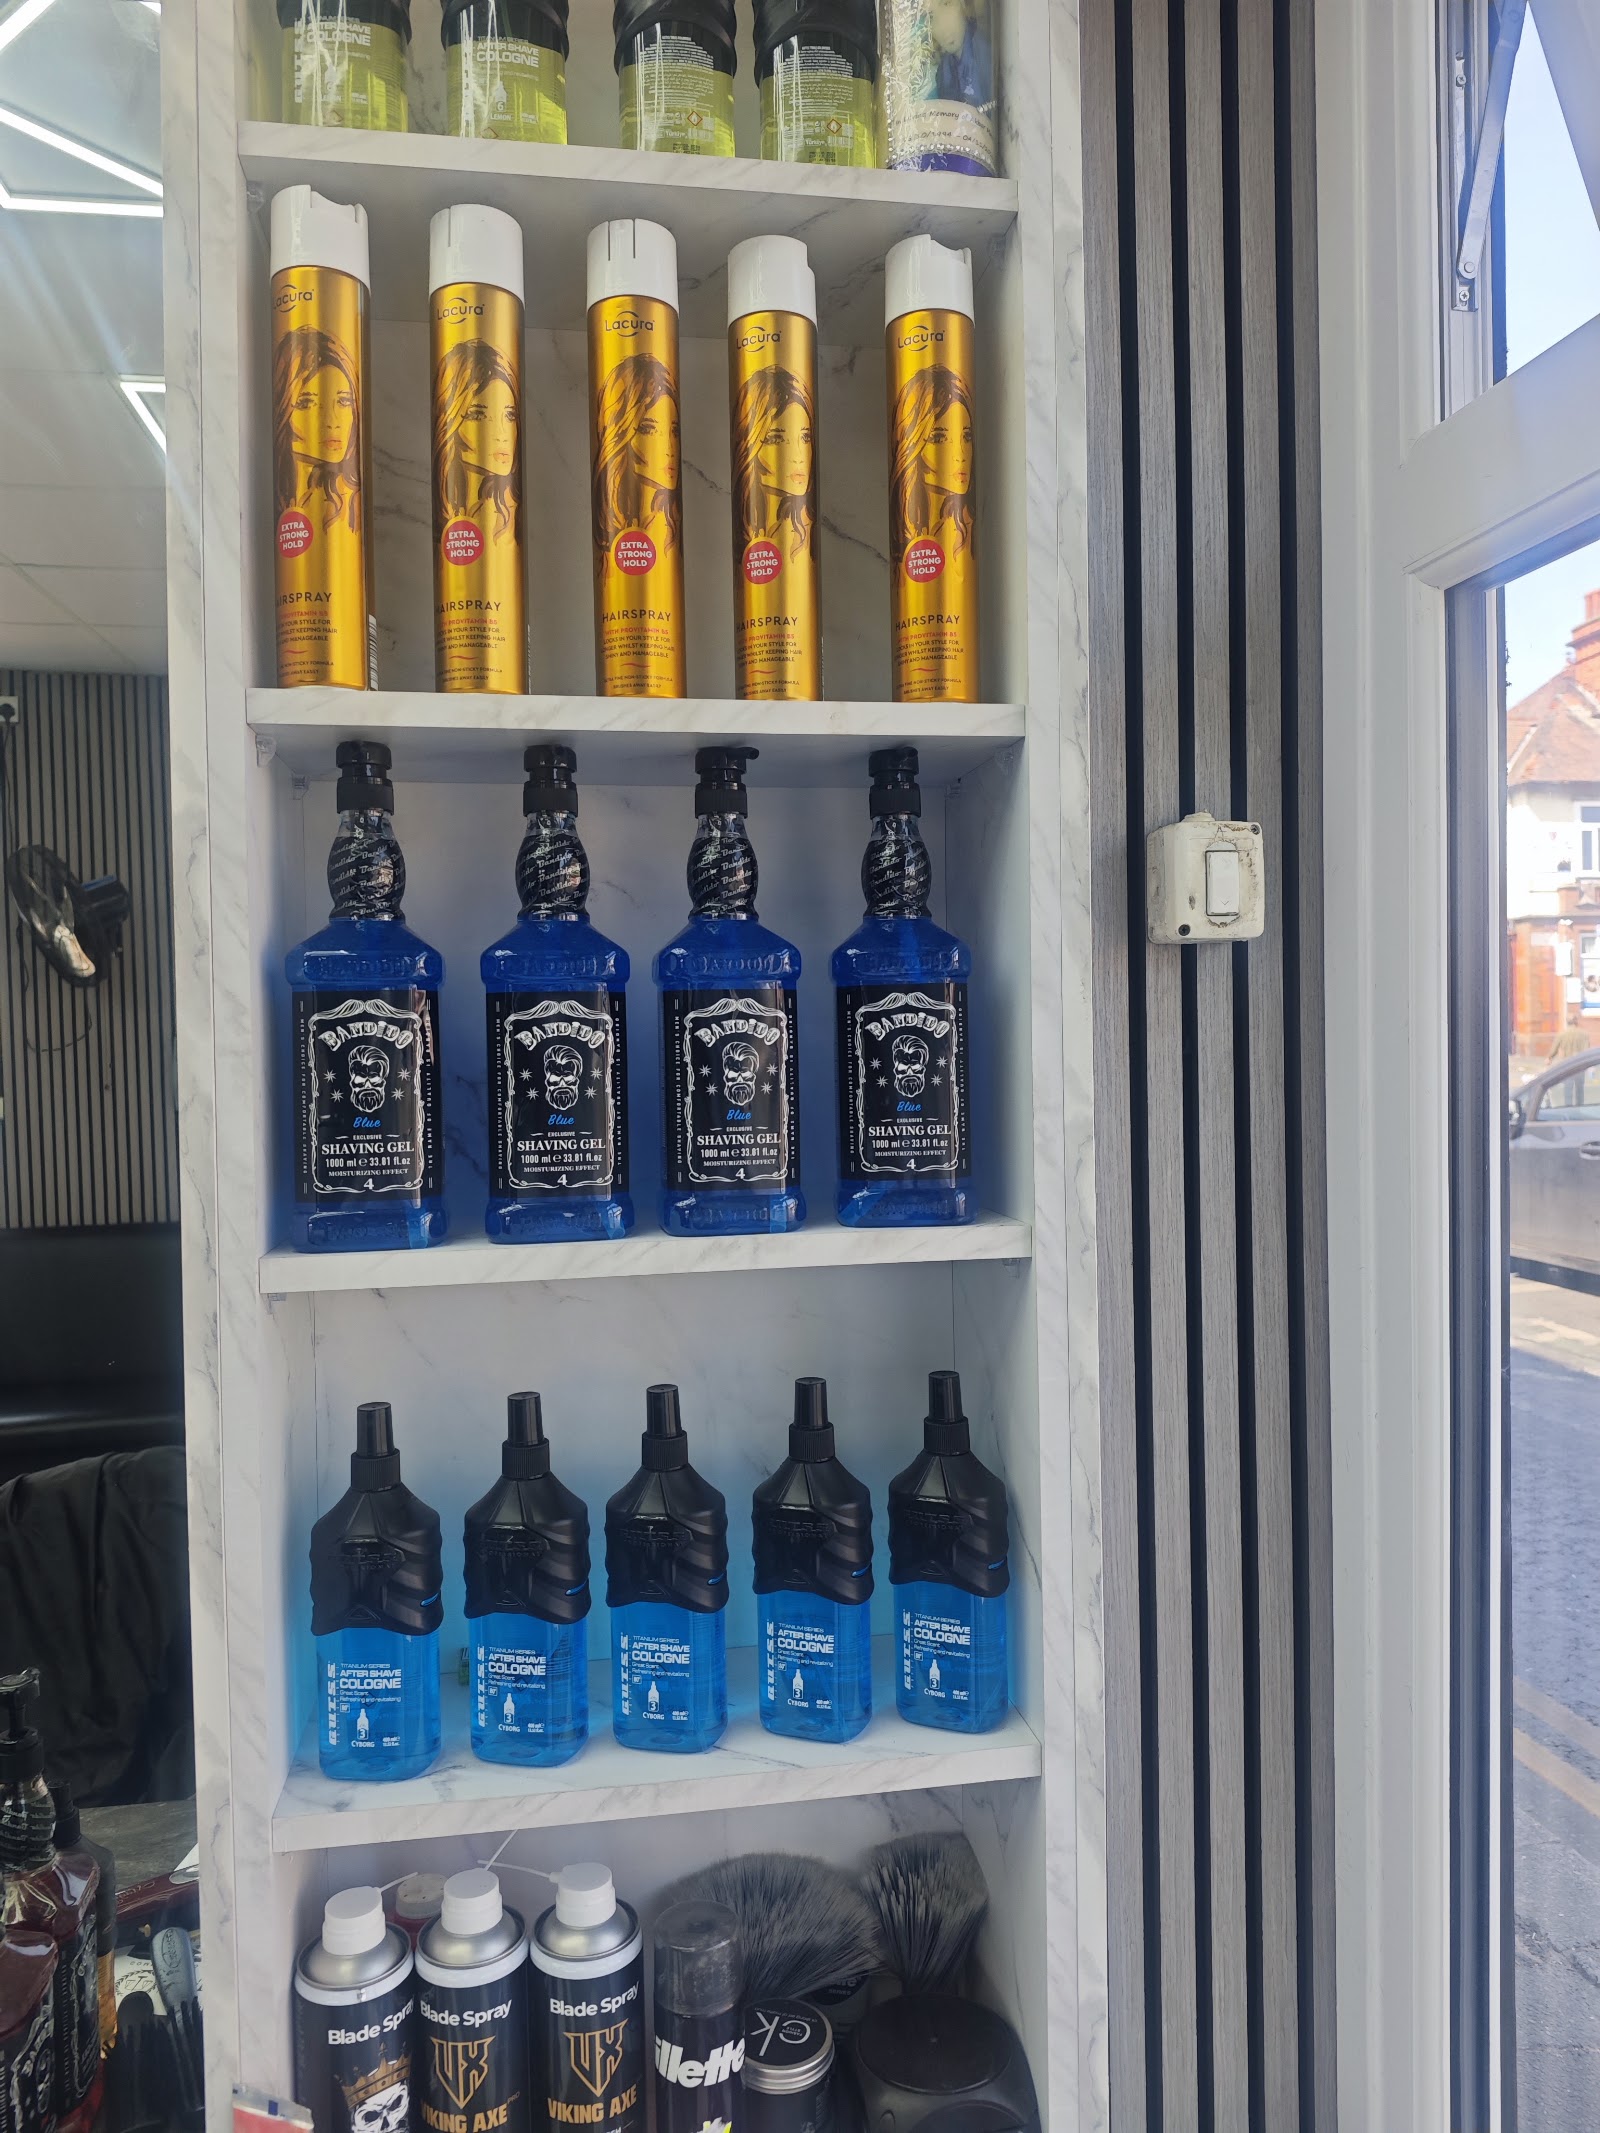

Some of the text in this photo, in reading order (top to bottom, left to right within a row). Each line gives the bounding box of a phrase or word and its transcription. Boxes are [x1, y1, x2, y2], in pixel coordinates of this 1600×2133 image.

[307, 31, 371, 46] COLOGNE
[508, 44, 539, 56] SHAVE
[477, 51, 539, 68] COLOGNE
[490, 113, 513, 121] LEMON
[437, 304, 483, 320] Lacura
[605, 320, 654, 332] Lacura
[736, 332, 780, 350] Lacura
[898, 331, 944, 349] Lacura
[282, 522, 305, 532] EXTRA
[280, 530, 309, 543] STRONG
[449, 531, 475, 540] EXTRA
[283, 541, 304, 551] HOLD
[446, 540, 480, 550] STRONG
[621, 542, 648, 550] EXTRA
[451, 549, 475, 558] HOLD
[618, 551, 653, 559] STRONG
[749, 551, 774, 560] EXTRA
[911, 549, 937, 559] EXTRA
[747, 559, 778, 570] STRONG
[908, 558, 941, 568] STRONG
[751, 569, 773, 577] HOLD
[913, 567, 936, 575] HOLD
[602, 610, 671, 624] HAIRSPRAY
[895, 615, 960, 631] HAIRSPRAY
[865, 1012, 950, 1041] BANDIDO
[318, 1021, 414, 1051] BANDIDO
[514, 1022, 606, 1051] BANDIDO
[694, 1019, 781, 1048] BANDIDO
[897, 1101, 922, 1112] Blue
[548, 1115, 575, 1125] Blue
[727, 1110, 751, 1120] Blue
[353, 1117, 381, 1128] Blue
[869, 1125, 951, 1137] SHAVING GEL
[517, 1139, 606, 1152] SHAVING GEL
[697, 1134, 781, 1146] SHAVING GEL
[872, 1140, 889, 1148] 1000
[892, 1139, 900, 1148] ml
[322, 1142, 414, 1155] SHAVING GEL
[701, 1149, 718, 1158] 1000
[721, 1148, 730, 1158] ml
[326, 1159, 344, 1168] 1000
[347, 1158, 357, 1167] ml
[521, 1155, 539, 1164] 1000
[542, 1154, 551, 1163] ml
[907, 1159, 916, 1169] 4
[736, 1168, 746, 1179] 4
[364, 1178, 374, 1190] 4
[558, 1174, 568, 1185] 4
[915, 1613, 939, 1621] TITANIUM
[914, 1620, 970, 1634] AFTER SHAVE
[778, 1629, 834, 1643] AFTER SHAVE
[914, 1628, 970, 1646] COLOGNE
[632, 1642, 690, 1652] AFTER SHAVE
[778, 1638, 834, 1654] COLOGNE
[488, 1653, 546, 1664] AFTER SHAVE
[632, 1651, 690, 1664] COLOGNE
[340, 1669, 401, 1678] AFTER SHAVE
[488, 1663, 546, 1676] COLOGNE
[340, 1678, 401, 1689] COLOGNE
[932, 1679, 937, 1688] 3
[795, 1689, 801, 1698] 3
[650, 1701, 656, 1710] 3
[506, 1713, 512, 1722] 3
[359, 1728, 366, 1739] 3
[550, 1980, 639, 2017] Blade Spray
[420, 1999, 512, 2028] Blade Spray
[328, 2024, 380, 2045] Blade
[655, 2035, 745, 2088] illette
[548, 2084, 637, 2124] VIKING AXE
[473, 2103, 508, 2132] AXE
